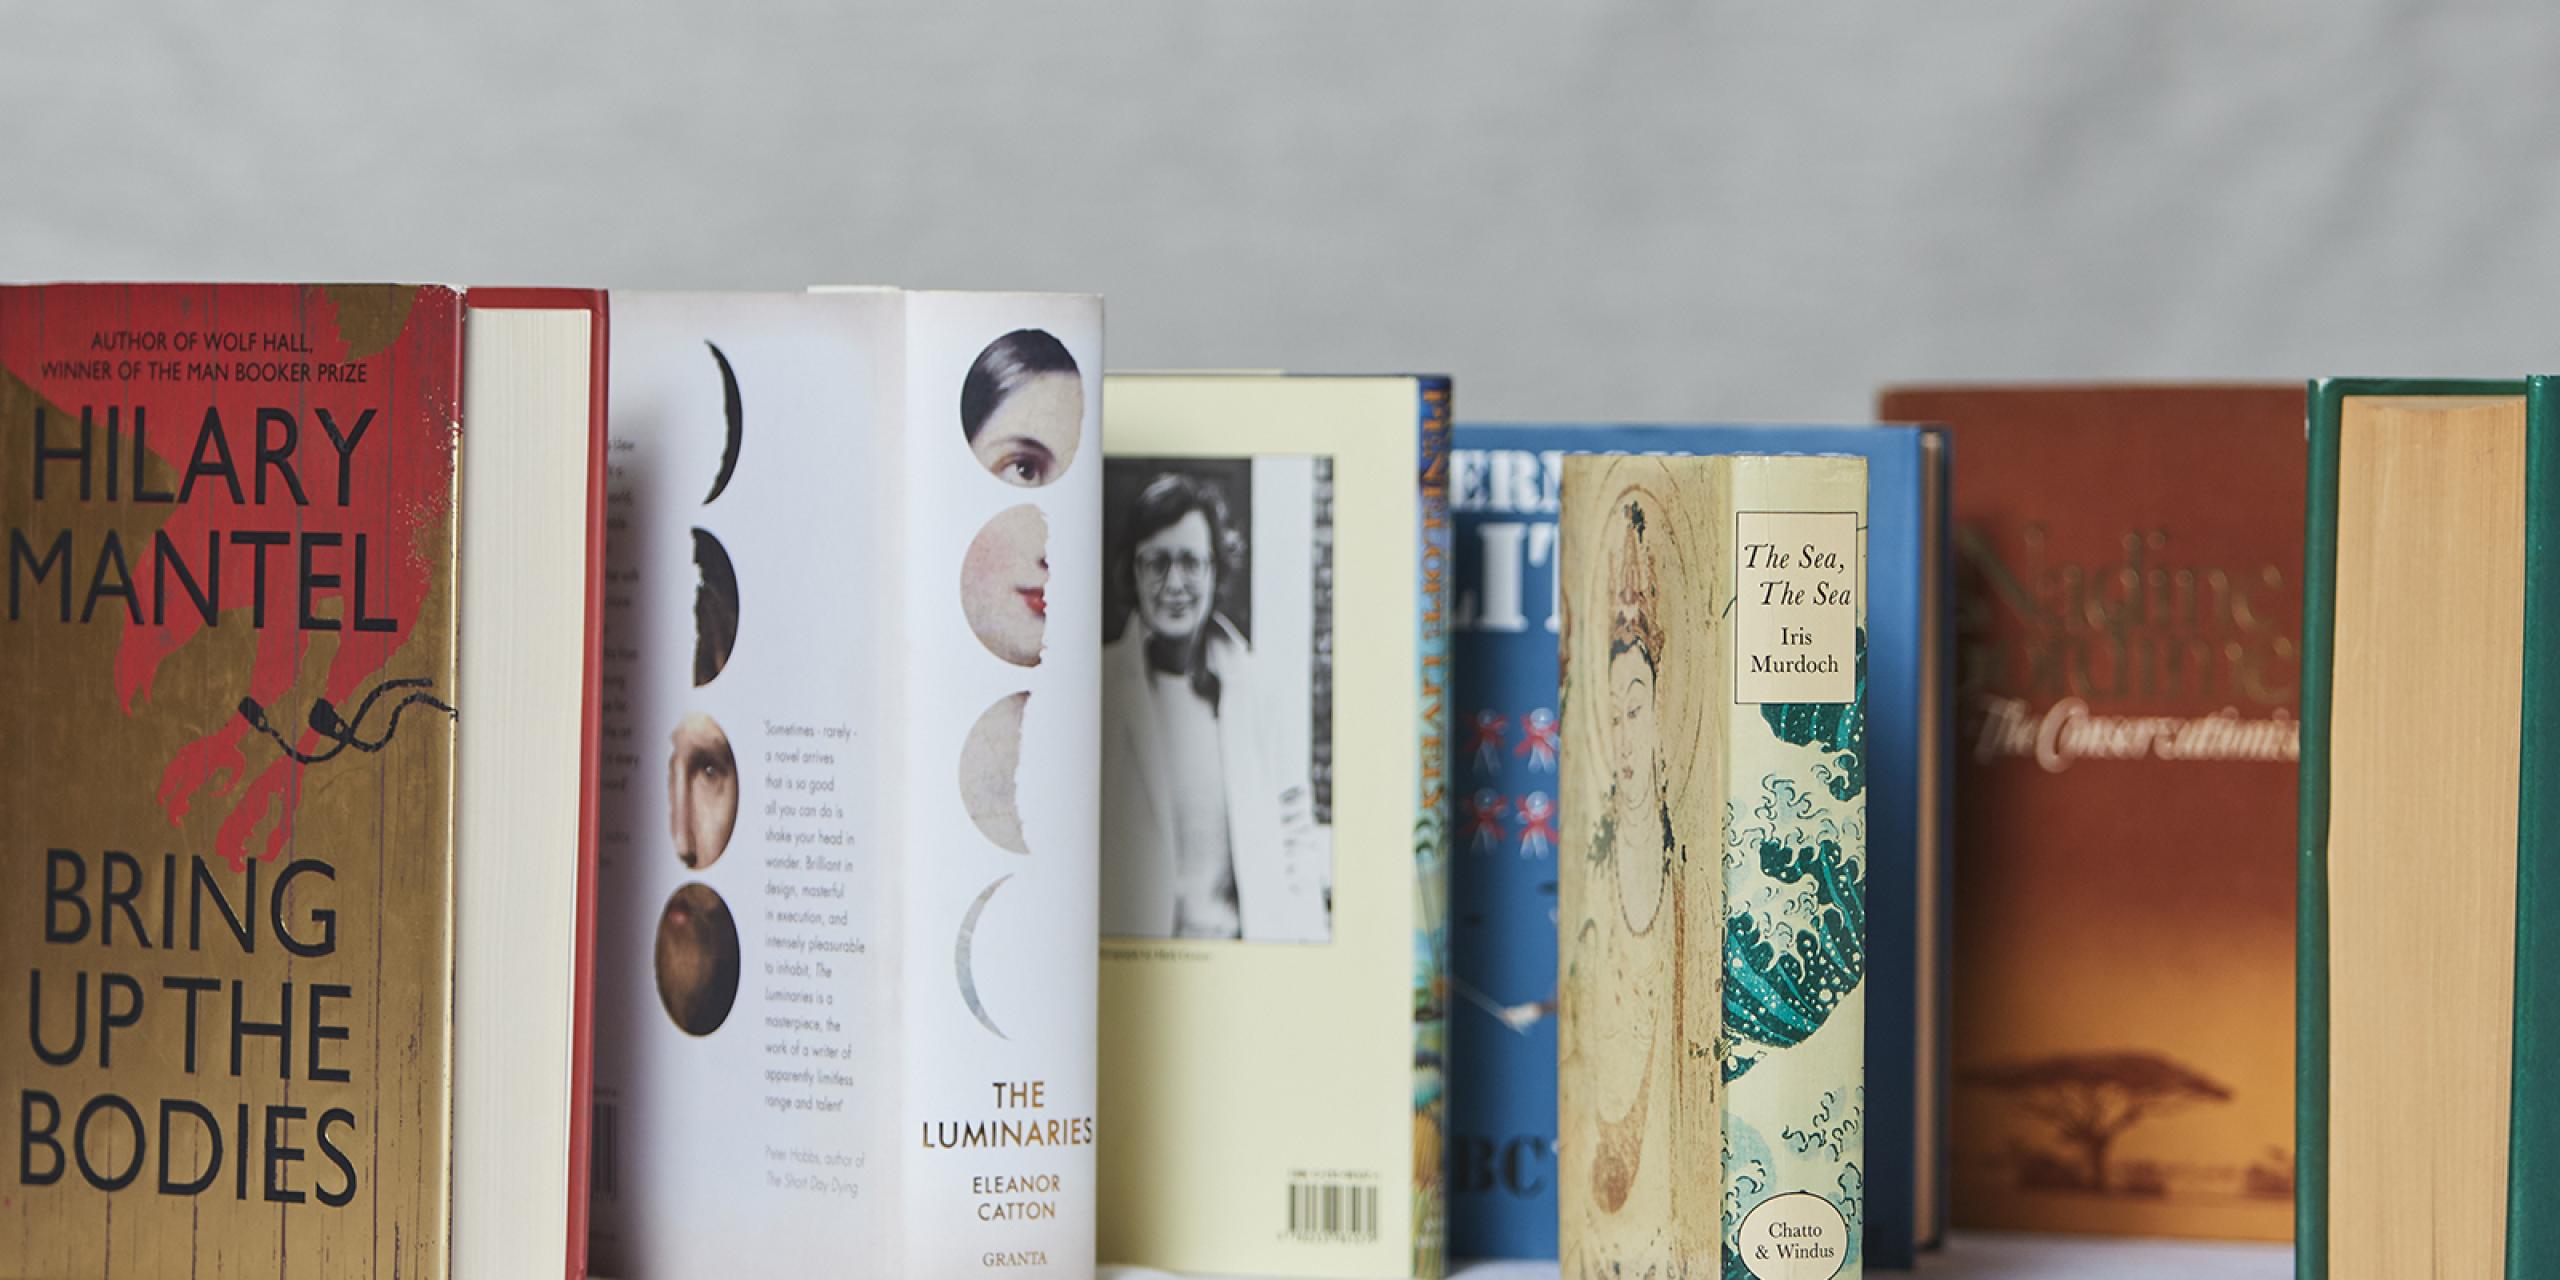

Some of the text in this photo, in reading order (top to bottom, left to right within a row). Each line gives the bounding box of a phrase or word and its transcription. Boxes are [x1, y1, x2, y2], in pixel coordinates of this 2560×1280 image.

[91, 331, 167, 352] AUTHOR
[173, 332, 198, 352] OF
[203, 332, 257, 353] WOLF
[41, 362, 367, 383] WINNER OF THE MAN BOOKER PRIZE
[33, 405, 378, 506] HILARY
[1744, 542, 1847, 575] The Sea,
[8, 527, 398, 633] MANTEL
[1759, 580, 1852, 607] The Sea
[1781, 626, 1814, 647] Iris
[1751, 653, 1840, 674] Murdoch
[823, 720, 852, 743] rarely
[1420, 655, 1449, 810] LIVELY
[764, 747, 835, 765] a novel arrives
[765, 773, 783, 789] that
[795, 779, 807, 791] so
[808, 776, 835, 796] good
[764, 799, 777, 816] all
[779, 803, 796, 820] you
[798, 804, 817, 818] can
[819, 802, 833, 818] do
[764, 826, 855, 849] shake your head in
[805, 854, 842, 872] Brilliant
[844, 856, 854, 873] in
[801, 881, 845, 899] masterful
[44, 848, 337, 958] BRING
[828, 910, 848, 927] and
[764, 932, 865, 955] intensely pleasurable
[764, 961, 774, 975] to
[815, 961, 832, 978] The
[825, 993, 833, 1006] a
[28, 969, 353, 1083] UP THE
[825, 1016, 841, 1033] the
[764, 1039, 853, 1060] work of a writer of
[764, 1067, 854, 1088] apparently limitless
[764, 1095, 793, 1113] range
[794, 1093, 813, 1111] and
[991, 1081, 1045, 1109] THE
[922, 1116, 1093, 1149] LUMINARIES
[20, 1089, 358, 1208] BODIES
[823, 1150, 853, 1168] author
[972, 1173, 1061, 1195] ELEANOR
[977, 1200, 1055, 1222] CATTON
[1768, 1221, 1823, 1239] Chatto
[982, 1249, 1048, 1268] GRANTA
[1754, 1242, 1835, 1260] & Windus
